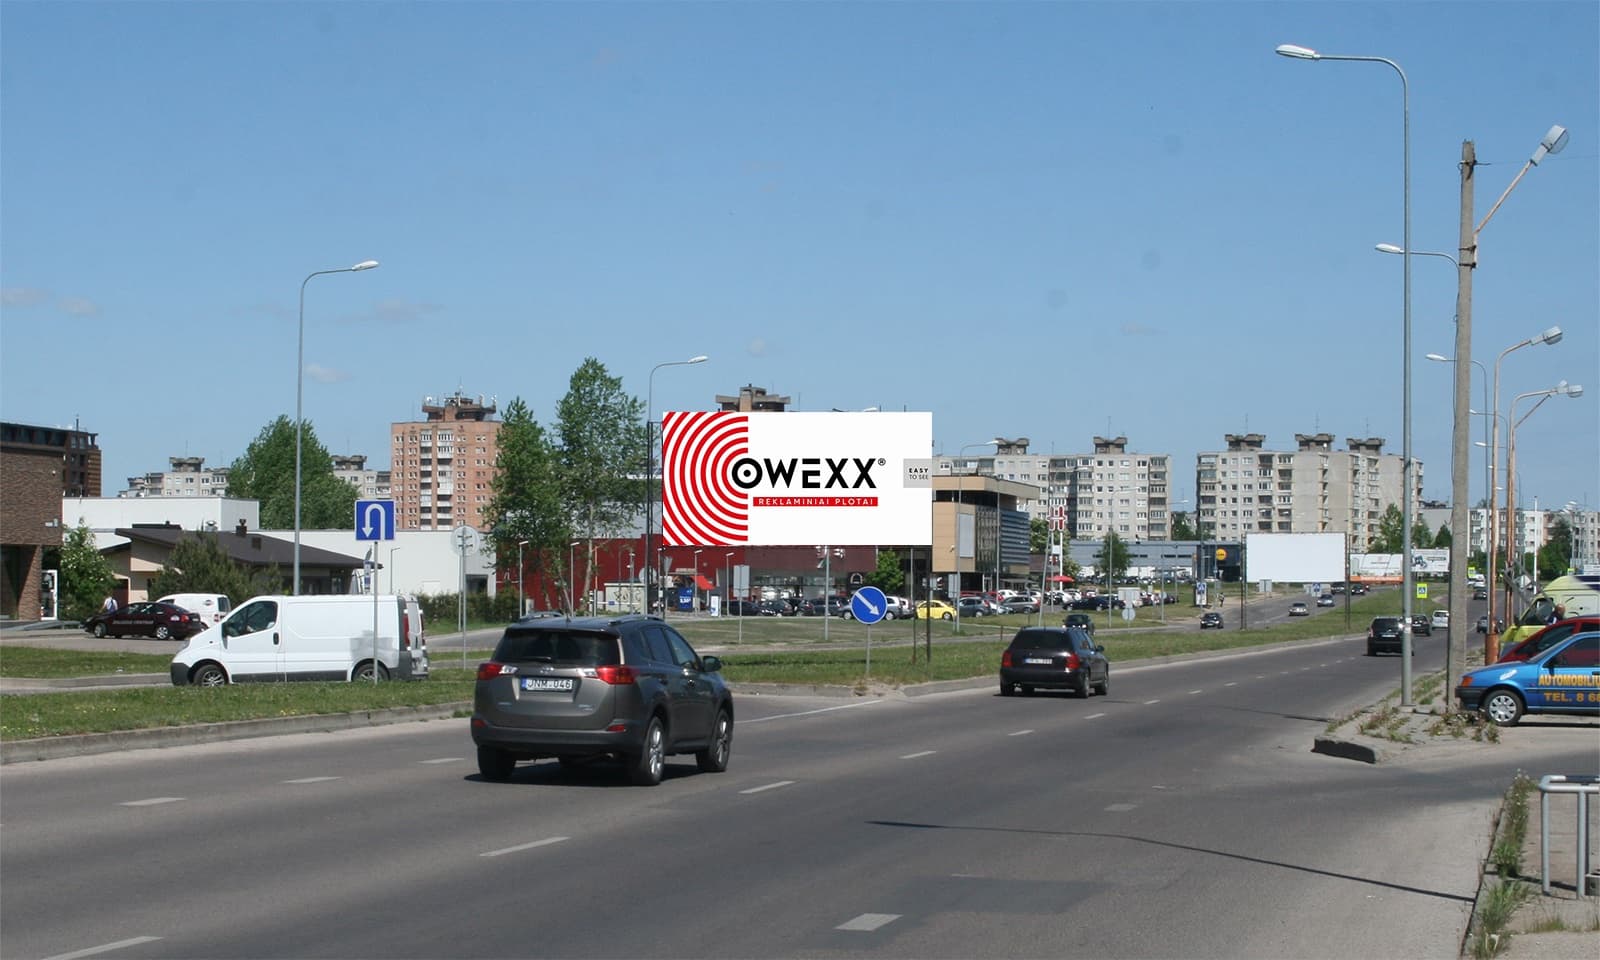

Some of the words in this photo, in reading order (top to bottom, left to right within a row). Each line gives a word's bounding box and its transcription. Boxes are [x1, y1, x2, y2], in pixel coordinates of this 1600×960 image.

[758, 498, 830, 506] REKLAMINIAI
[835, 498, 874, 506] PLOTAI
[1543, 691, 1573, 703] TEL.
